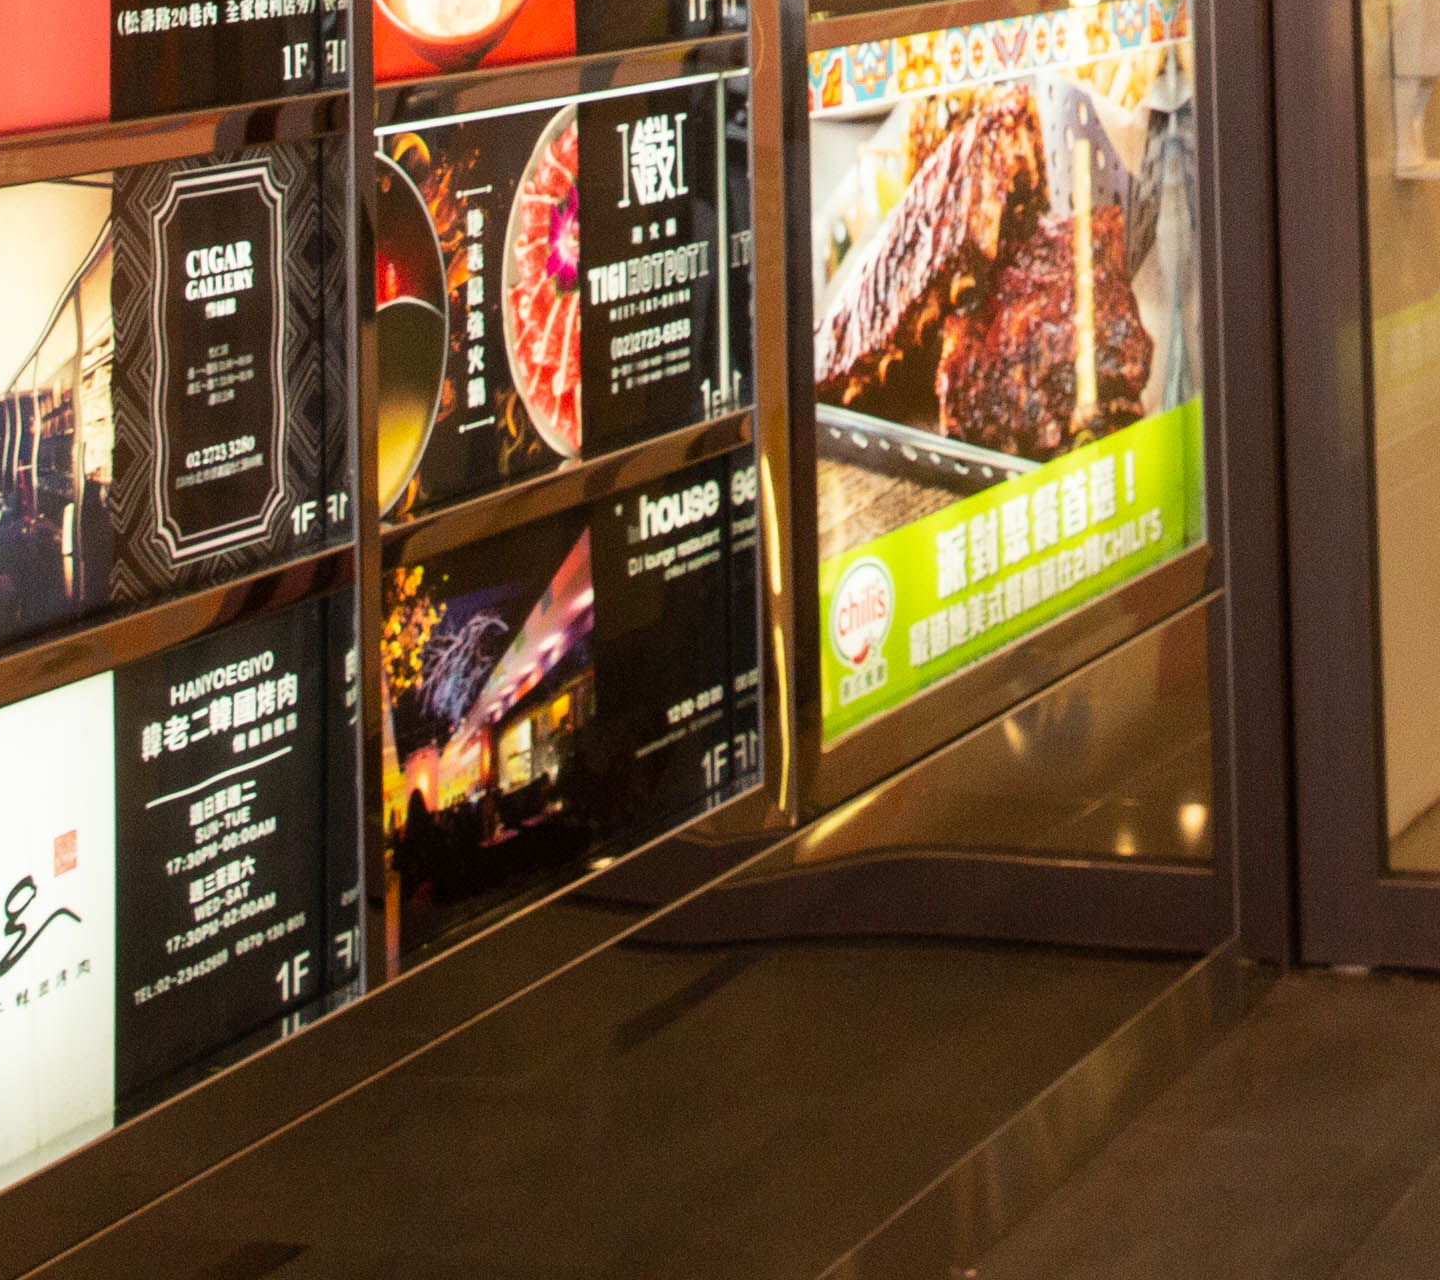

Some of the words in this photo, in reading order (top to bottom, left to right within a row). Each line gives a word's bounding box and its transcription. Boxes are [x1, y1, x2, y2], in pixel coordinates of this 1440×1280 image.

[282, 42, 310, 81] 1F
[185, 240, 253, 280] CIGAR
[185, 269, 255, 302] GALLERY
[291, 500, 317, 536] 1F
[639, 479, 721, 542] house
[170, 650, 275, 707] HANYOEGIYO
[701, 742, 729, 789] 1F
[276, 950, 311, 1002] 1F
